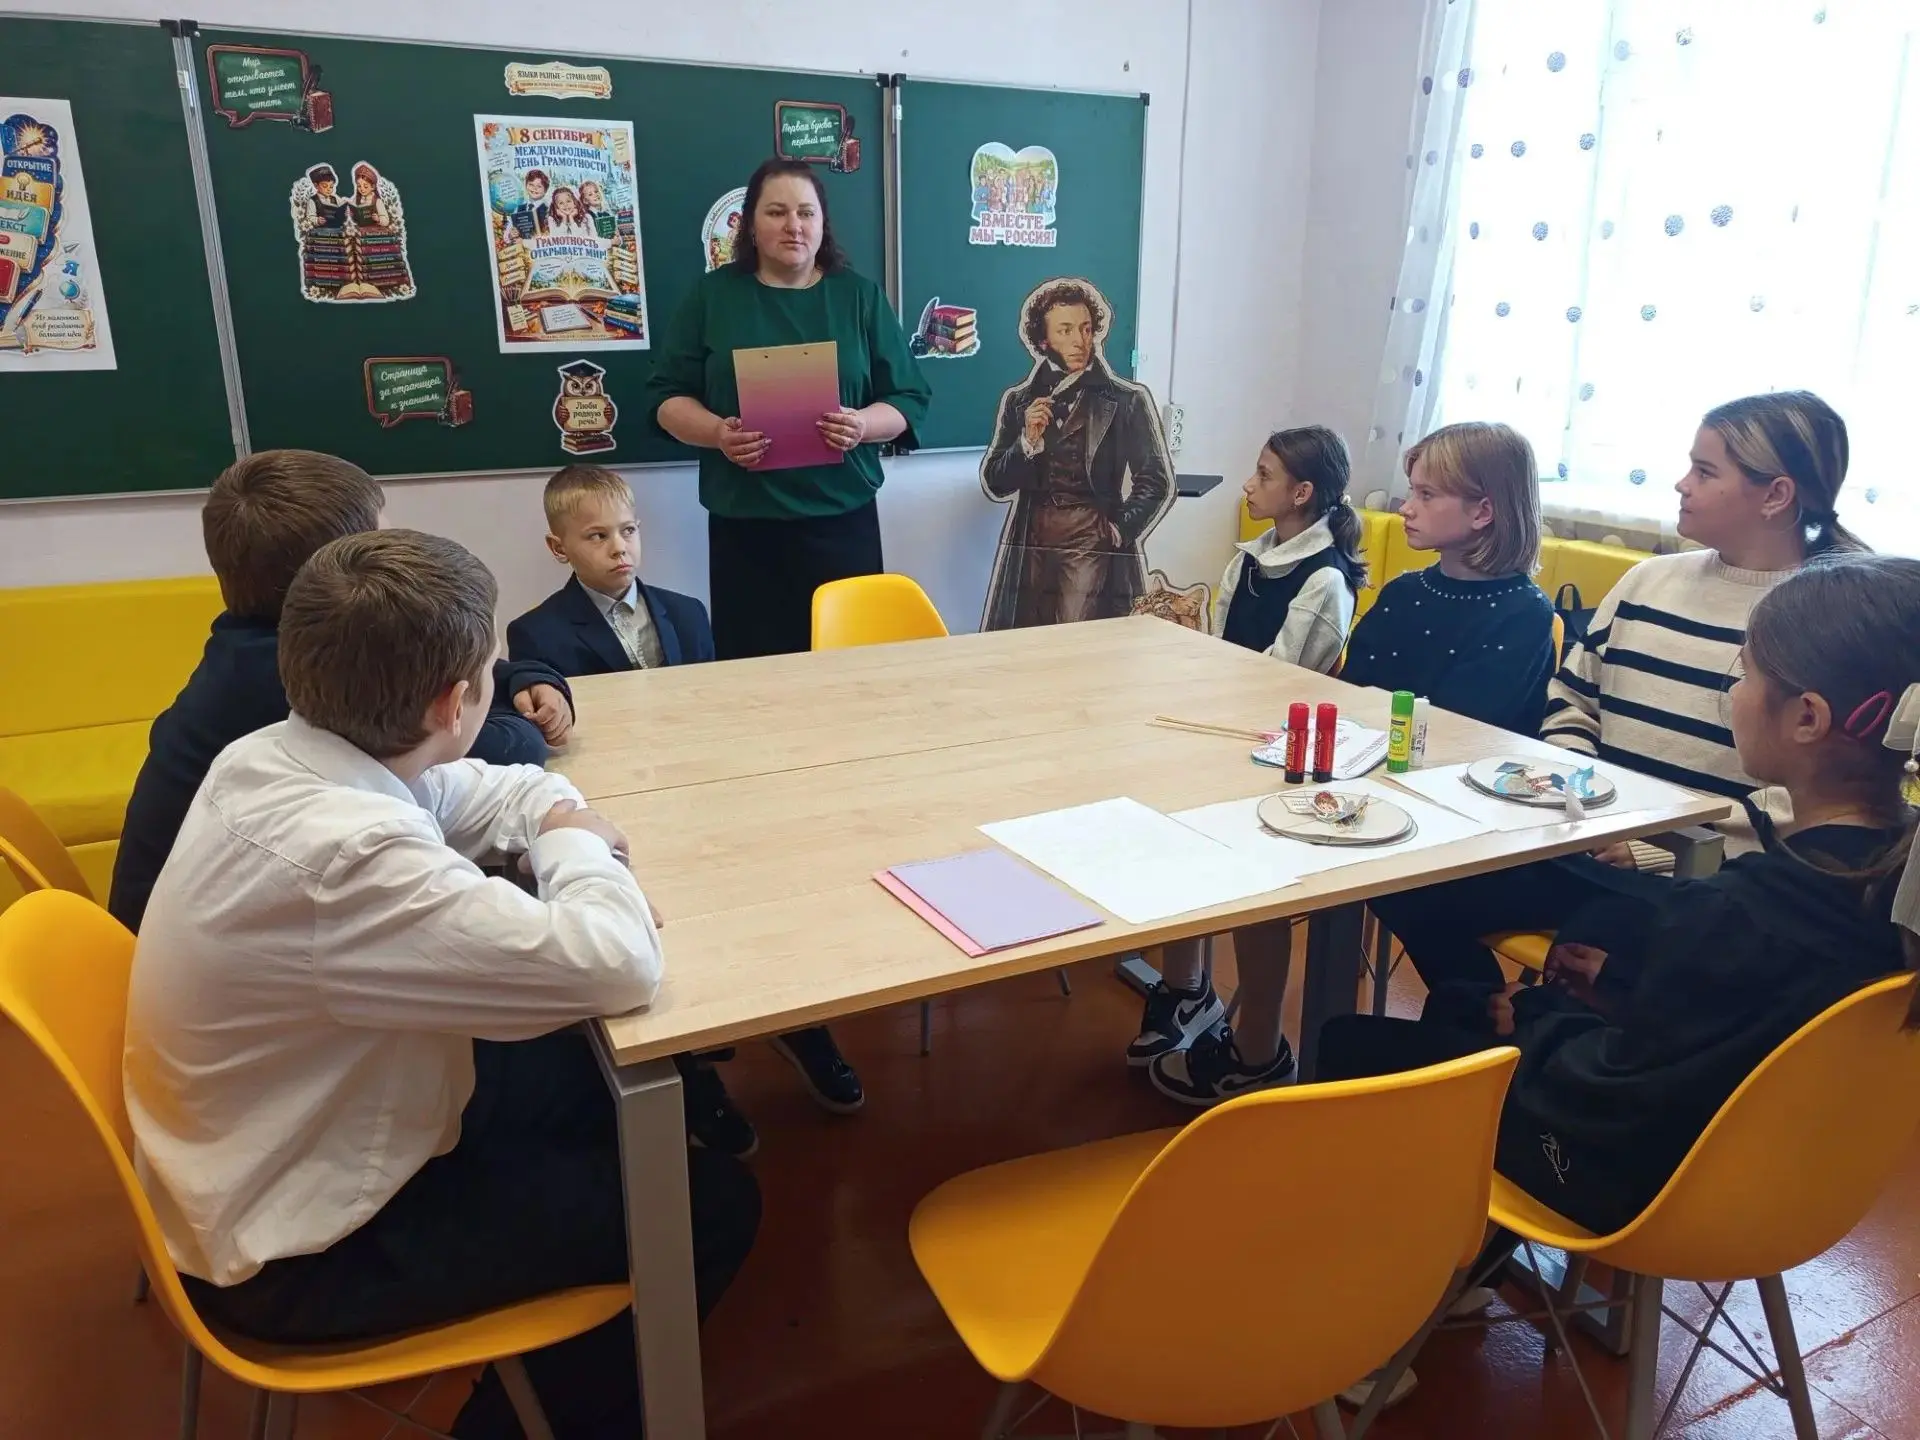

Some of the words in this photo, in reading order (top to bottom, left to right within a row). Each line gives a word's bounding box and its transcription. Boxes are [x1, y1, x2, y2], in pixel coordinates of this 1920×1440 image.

[242, 58, 261, 68] Мир
[227, 69, 285, 84] открывается
[268, 82, 295, 96] умеет
[782, 121, 810, 136] Первая
[520, 128, 530, 143] 8
[533, 128, 593, 144] СЕНТЯБРЯ
[791, 134, 818, 148] первый
[515, 146, 601, 160] МЕЖДУНАРОДНЫЙ
[7, 160, 52, 172] ОТКРЫТИЕ
[514, 157, 540, 169] ДЕНЬ
[541, 156, 607, 173] ГРАМОТНОСТИ
[6, 189, 37, 202] ИДЕЯ
[981, 213, 1044, 230] ВМЕСТЕ
[536, 236, 599, 248] ГРАМОТНОСТЬ
[530, 246, 584, 260] ОТКРЫВАЕТ
[586, 247, 607, 260] МИР!
[381, 365, 428, 381] Страница
[379, 390, 392, 400] за
[392, 376, 441, 395] страницей
[575, 401, 598, 410] Люби
[573, 411, 601, 419] родную
